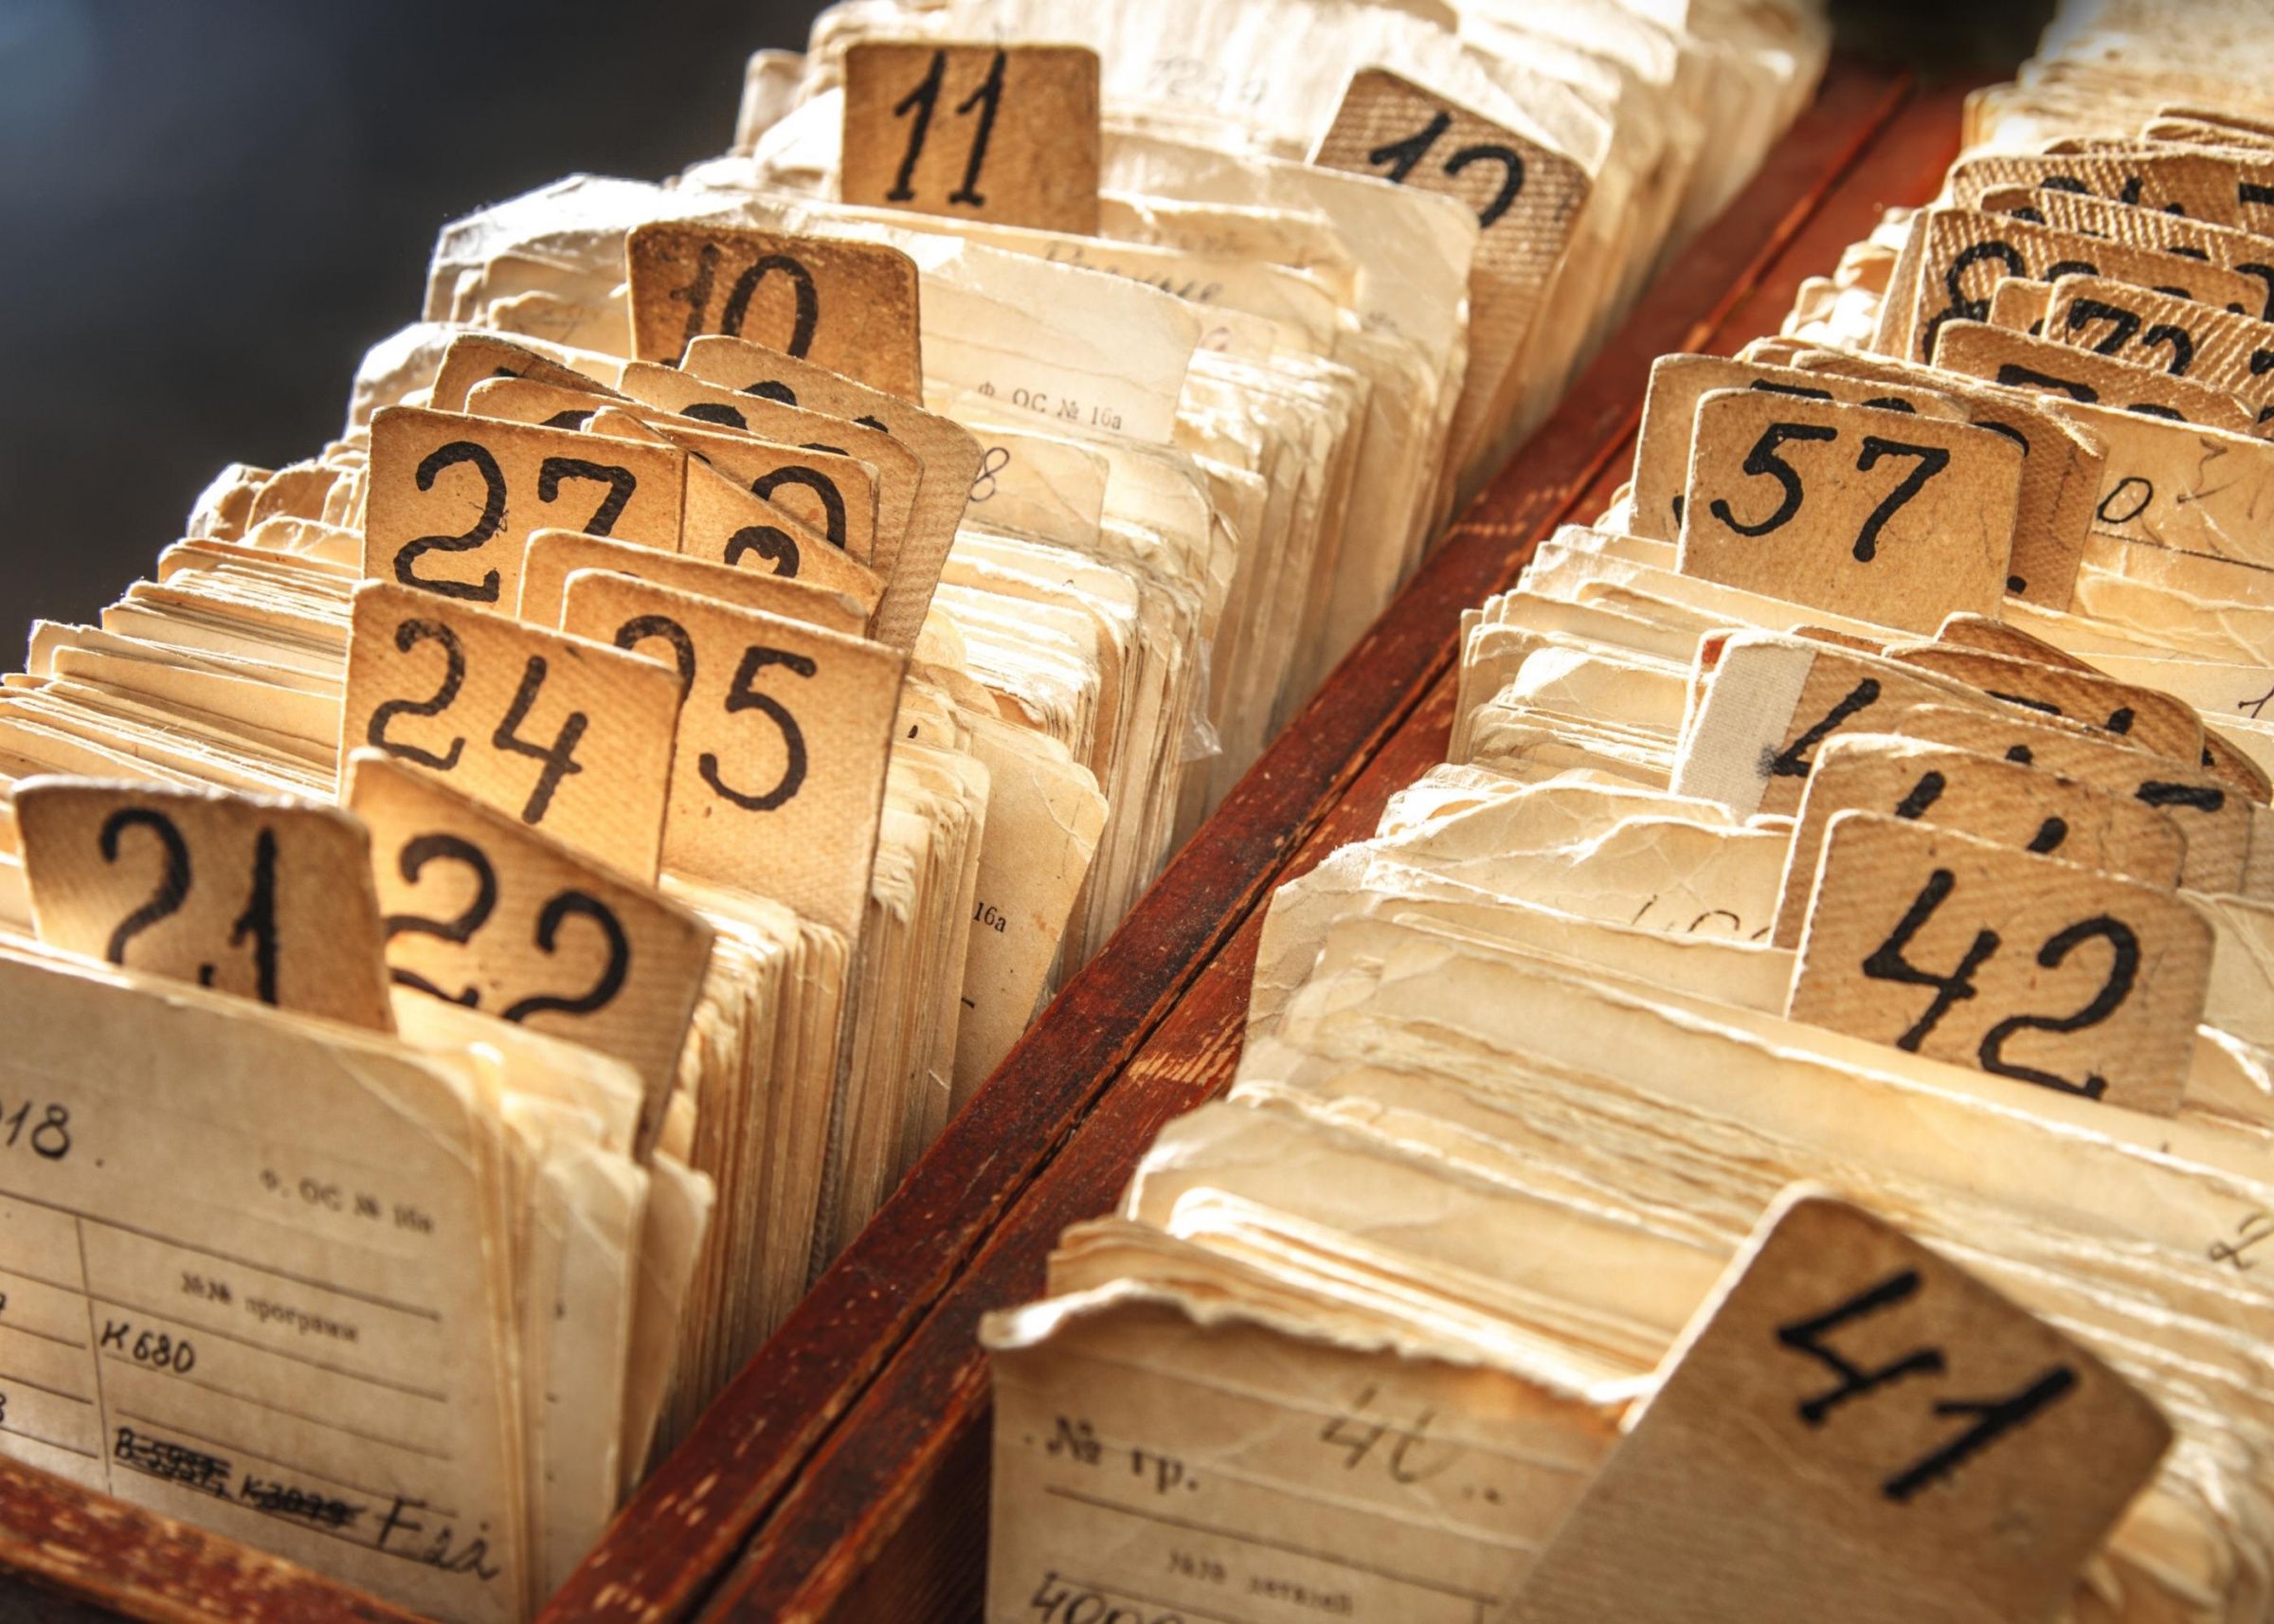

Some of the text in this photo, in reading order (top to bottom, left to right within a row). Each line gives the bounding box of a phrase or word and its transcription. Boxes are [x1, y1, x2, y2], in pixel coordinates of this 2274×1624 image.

[886, 49, 1007, 207] 11
[669, 244, 819, 370] 10
[1056, 398, 1080, 422] №
[392, 440, 637, 603] 27
[1709, 423, 1951, 564] 57
[367, 617, 588, 824] 24
[99, 806, 280, 1005] 21
[383, 833, 629, 1024] 22
[1861, 868, 2141, 1101] 42
[0, 1100, 71, 1162] 18
[1775, 1268, 2078, 1508] 41
